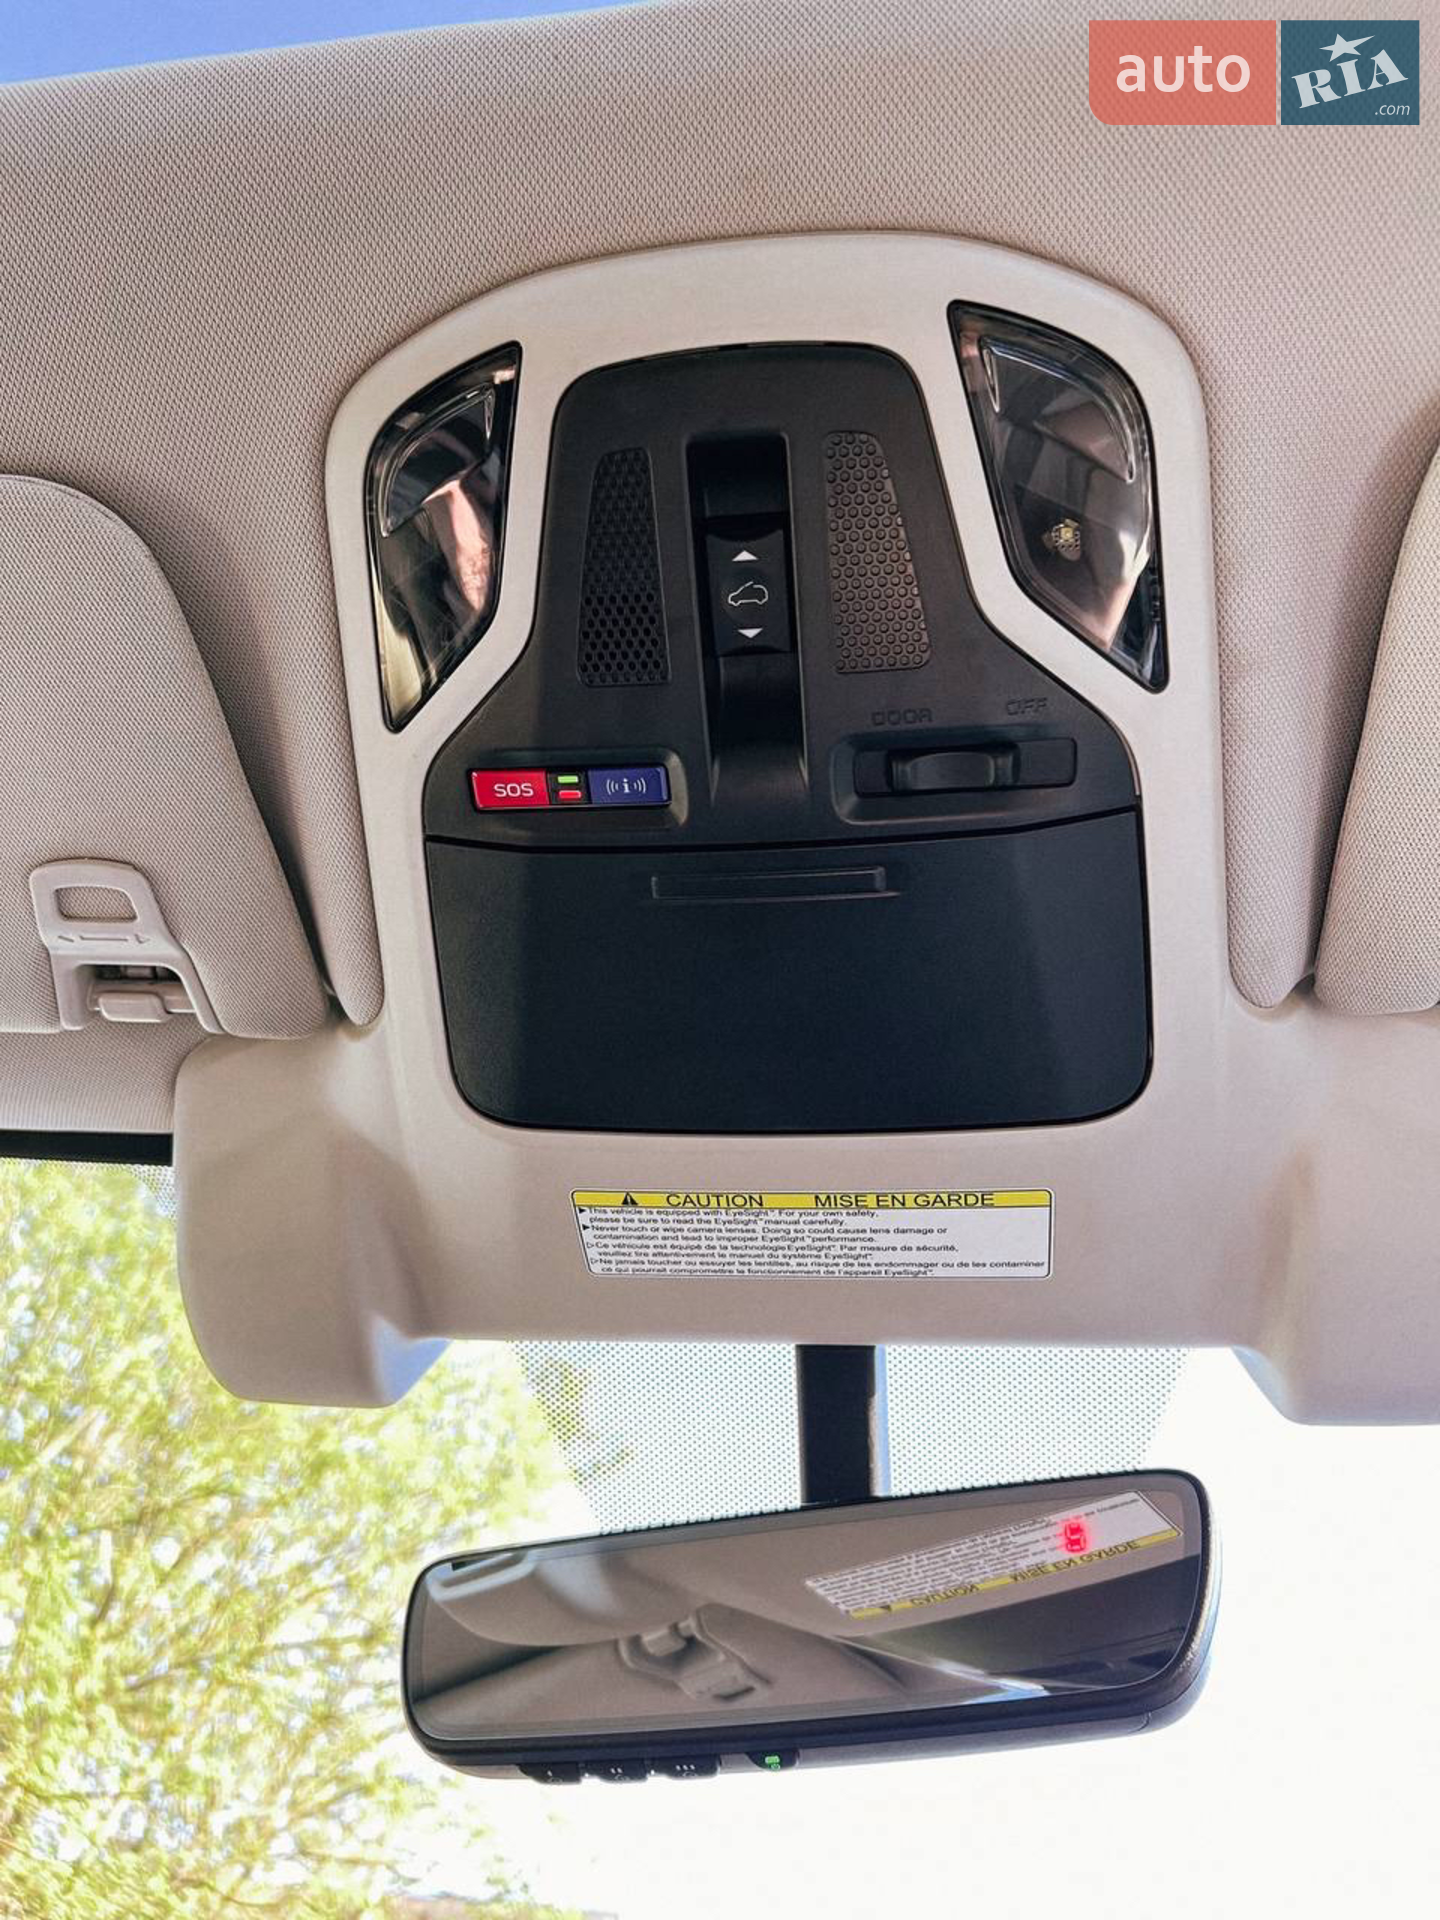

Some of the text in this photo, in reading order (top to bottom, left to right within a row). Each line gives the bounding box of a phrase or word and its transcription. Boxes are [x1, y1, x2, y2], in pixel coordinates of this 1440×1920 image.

[871, 697, 1048, 726] DOOR OFF
[494, 783, 534, 797] SOS
[665, 1192, 995, 1208] CAUTION MISE EN GARDE
